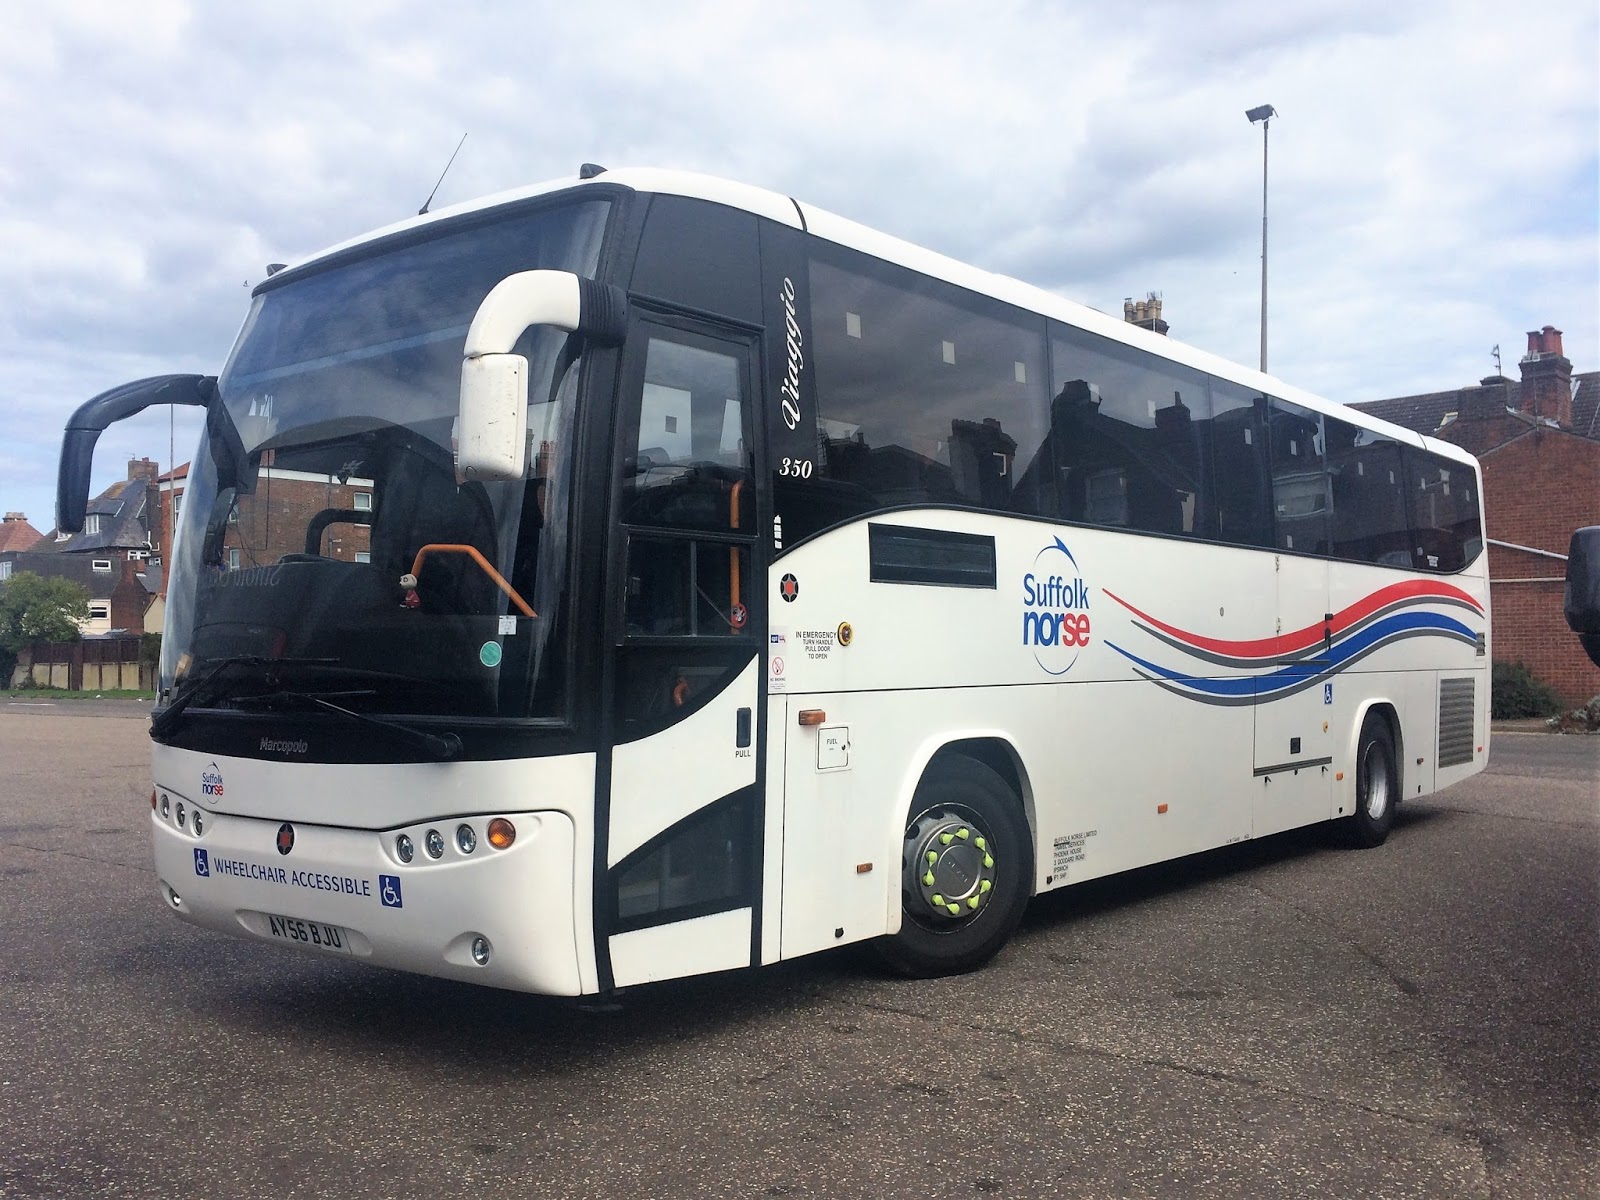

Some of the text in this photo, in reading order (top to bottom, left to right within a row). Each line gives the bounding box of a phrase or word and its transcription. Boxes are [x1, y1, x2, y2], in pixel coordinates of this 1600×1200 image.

[781, 277, 804, 431] Viaggio
[779, 457, 812, 479] 350
[1023, 573, 1090, 609] Suffolk
[802, 631, 837, 639] EMERGENCY
[1023, 611, 1090, 648] norse
[260, 736, 308, 756] Marcopolo
[735, 750, 751, 758] PULL
[202, 772, 224, 785] Suffolk
[202, 783, 224, 796] norse
[213, 857, 371, 897] WHEELCHAIR ACCESSIBLE
[269, 916, 342, 948] AY56 BJU
